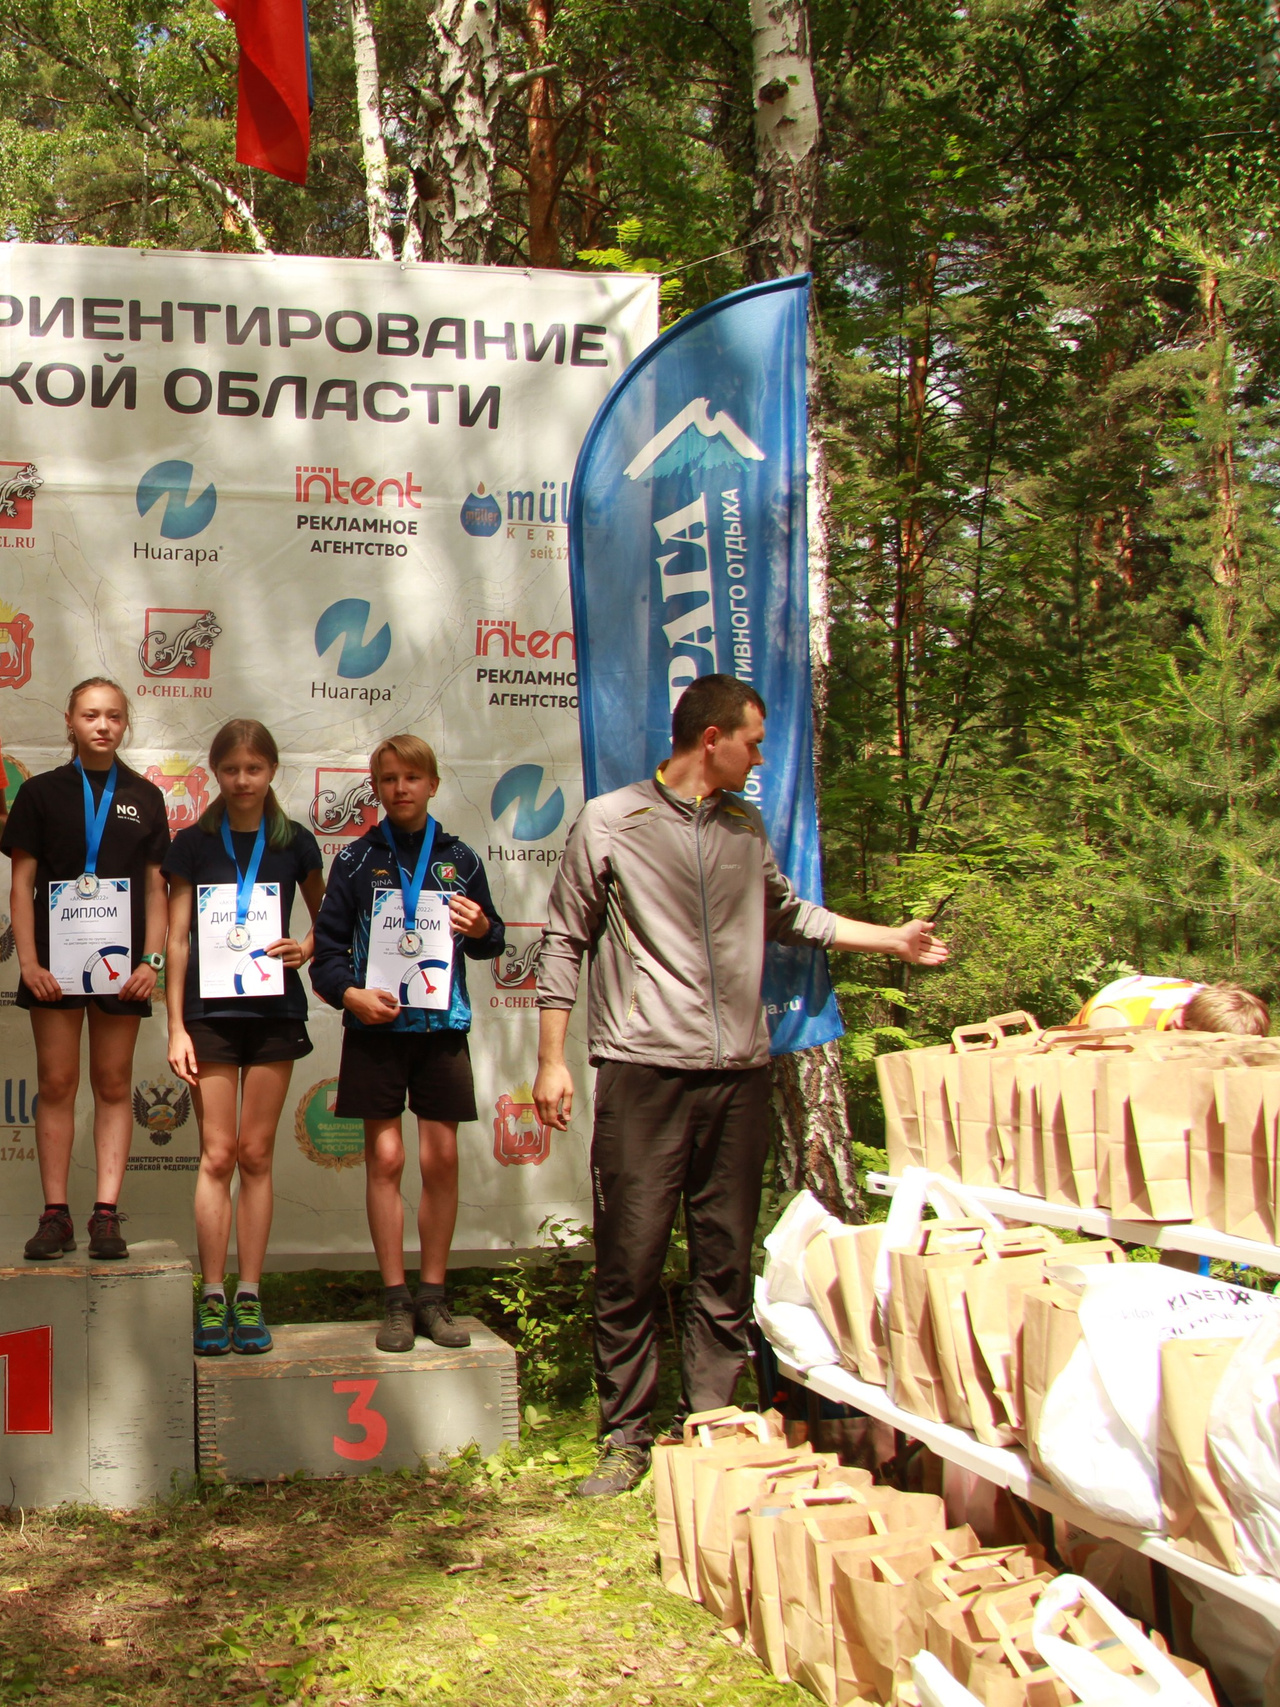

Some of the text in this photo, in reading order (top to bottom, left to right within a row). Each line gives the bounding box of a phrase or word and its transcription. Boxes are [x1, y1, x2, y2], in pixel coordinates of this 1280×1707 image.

[163, 366, 501, 429] ОБЛАСТИ
[295, 466, 423, 509] intent
[507, 481, 569, 524] mül
[296, 514, 418, 536] РЕКЛАМНОЕ
[720, 487, 747, 578] ОТДЫХА
[133, 542, 219, 567] Ниагара
[310, 539, 408, 558] АГЕНТСТВО
[530, 548, 554, 559] seit
[475, 619, 576, 661] inten
[476, 668, 579, 687] РЕКЛАМНО
[136, 684, 213, 699] O-CHEL.RU
[311, 681, 392, 706] Ниагара
[116, 804, 140, 819] NO.
[370, 878, 394, 888] DINA
[61, 906, 118, 922] ДИПЛОМ
[210, 910, 268, 924] ДИПОМ
[0, 991, 19, 999] СПОР
[0, 1147, 36, 1162] 1744
[126, 1163, 199, 1172] ССИЙСКОЙ ФЕДЕРАЦИ
[331, 1379, 389, 1461] 3
